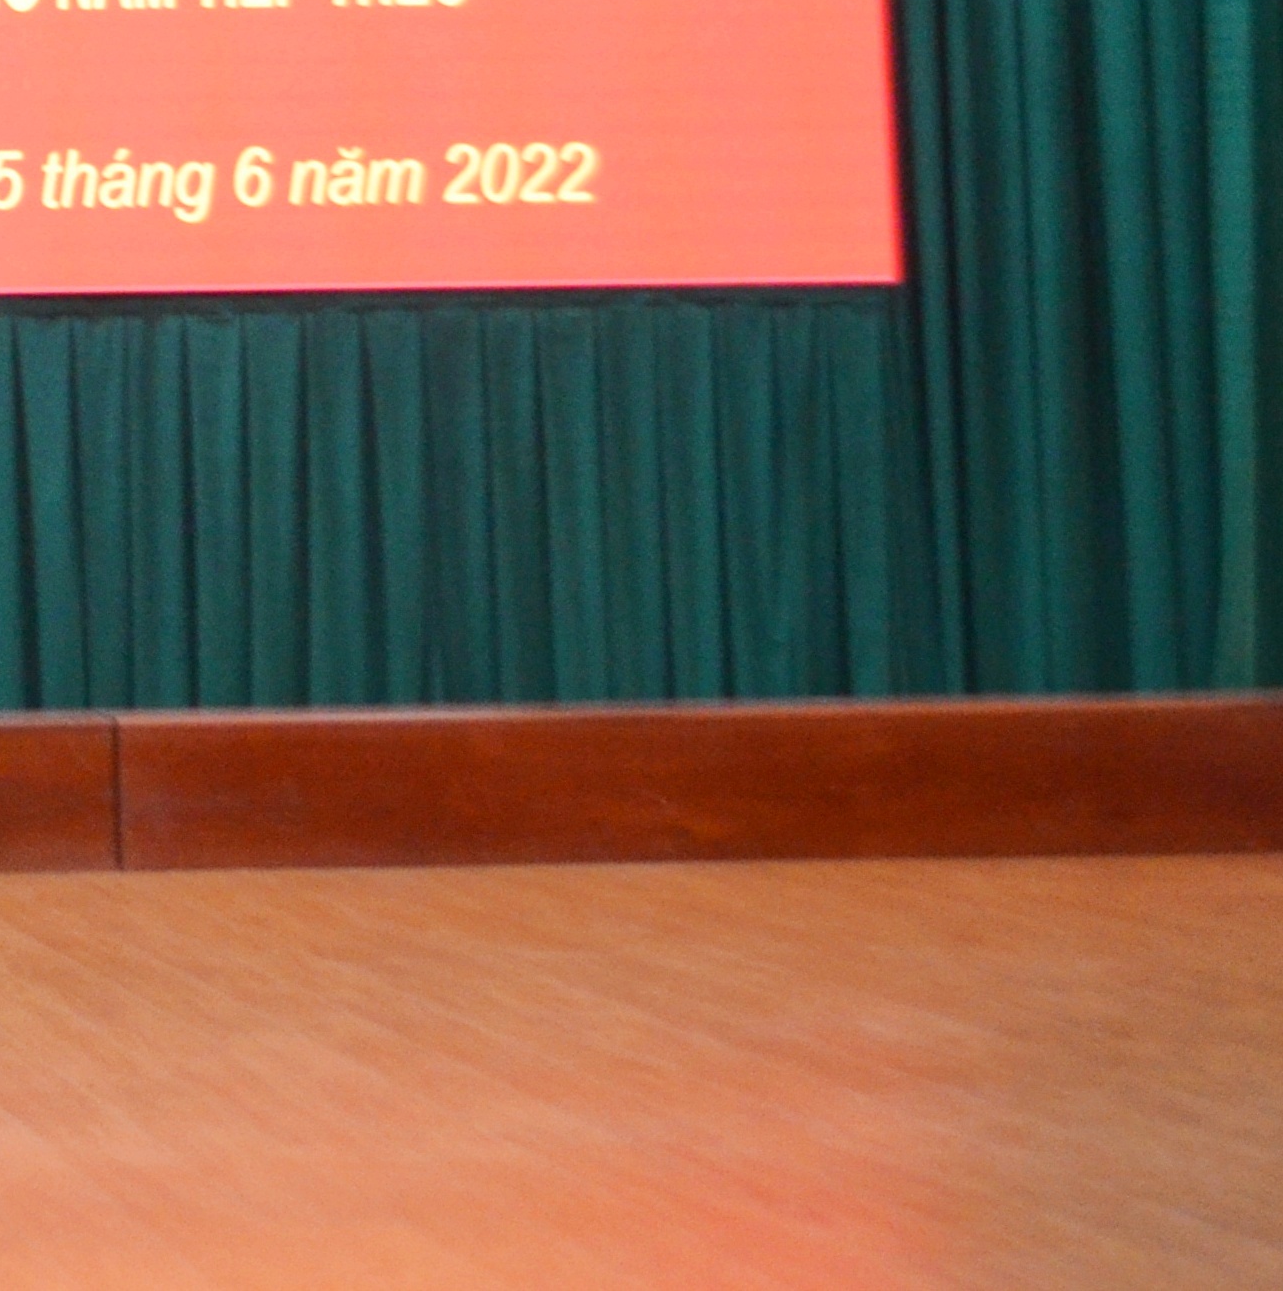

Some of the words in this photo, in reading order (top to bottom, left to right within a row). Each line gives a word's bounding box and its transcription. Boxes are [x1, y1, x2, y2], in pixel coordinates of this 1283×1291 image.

[41, 147, 214, 223] tháng
[234, 145, 271, 206] 6
[289, 145, 423, 205] năm
[443, 142, 597, 203] 2022
